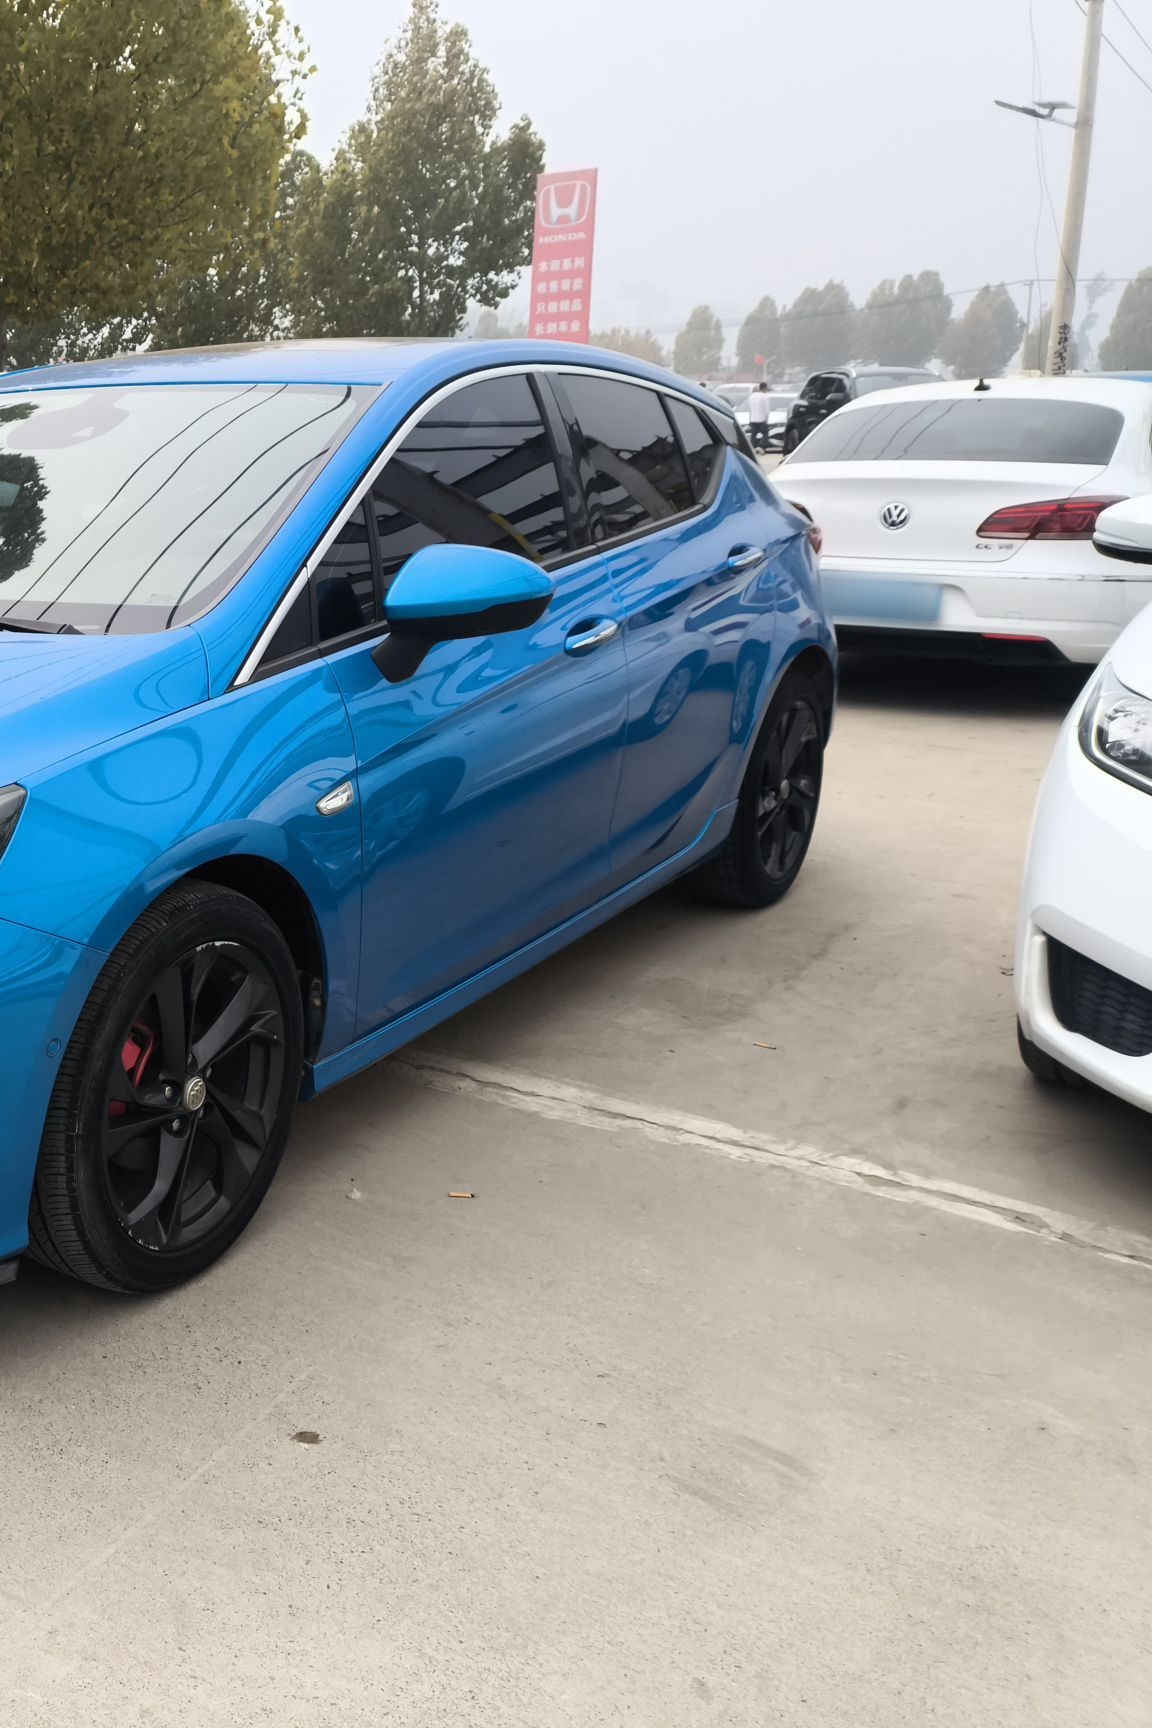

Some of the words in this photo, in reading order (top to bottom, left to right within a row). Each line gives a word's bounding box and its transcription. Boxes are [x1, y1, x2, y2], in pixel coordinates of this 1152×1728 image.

[538, 231, 586, 244] HONDA
[538, 257, 585, 272] 本田系列
